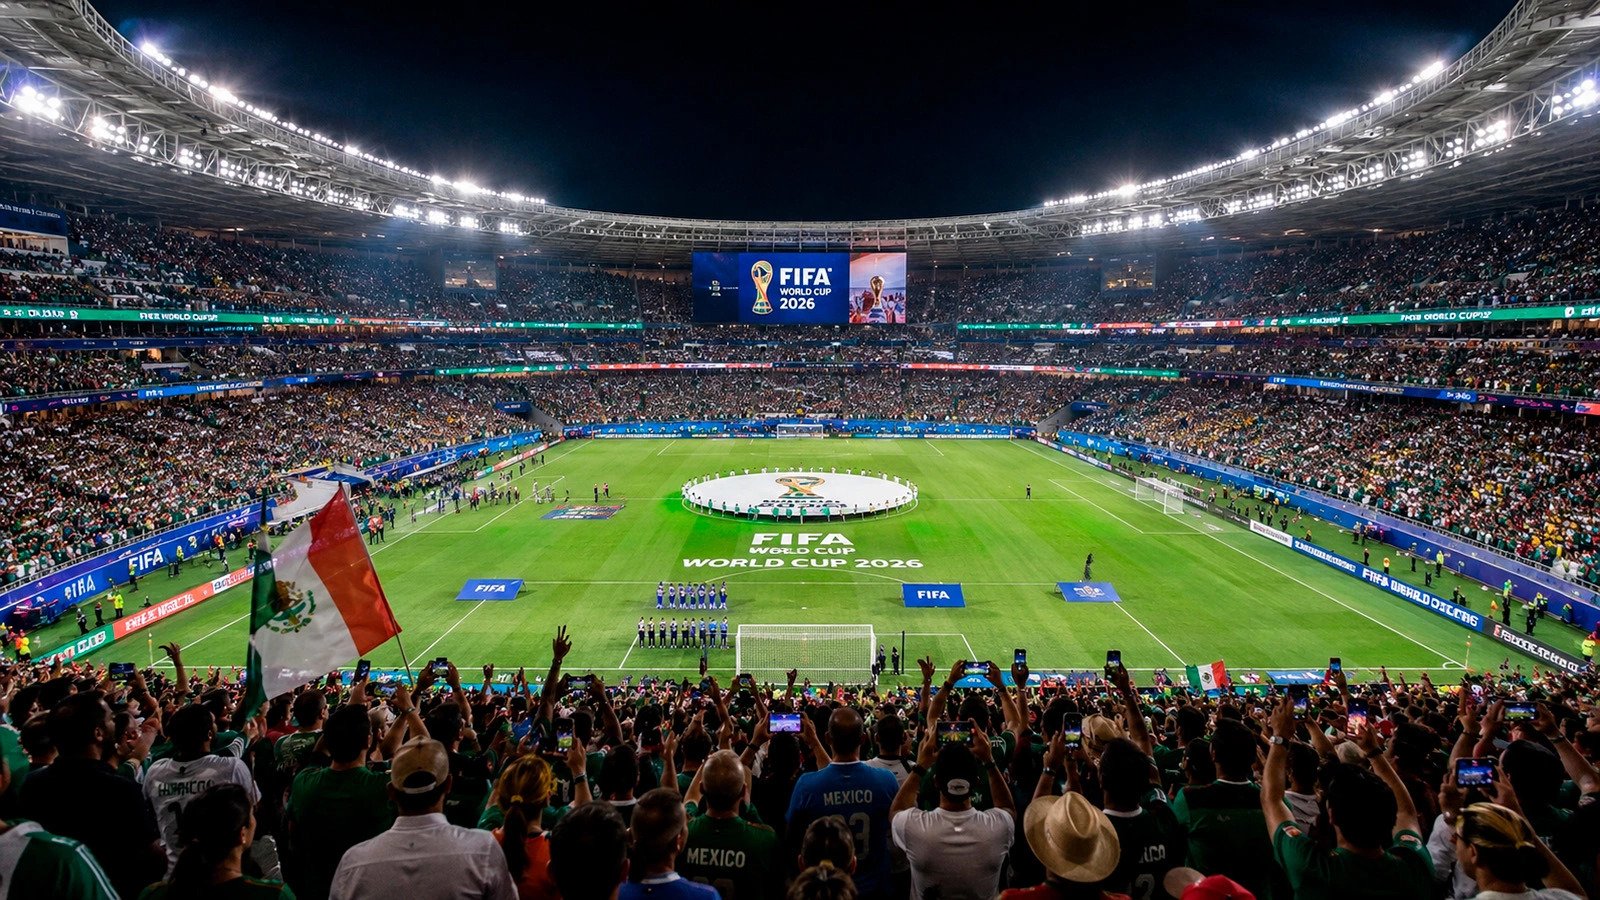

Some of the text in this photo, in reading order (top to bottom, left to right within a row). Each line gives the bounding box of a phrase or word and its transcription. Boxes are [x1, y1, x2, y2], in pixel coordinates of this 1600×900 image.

[780, 268, 831, 285] FIFA
[780, 298, 815, 309] 2026
[751, 533, 854, 545] FIFA
[814, 547, 856, 555] CUP
[683, 558, 924, 568] WORLD CUP 2026
[475, 584, 506, 593] FIFA
[917, 590, 950, 599] FIFA
[823, 789, 873, 806] MEXICO
[686, 847, 746, 868] MEXICO
